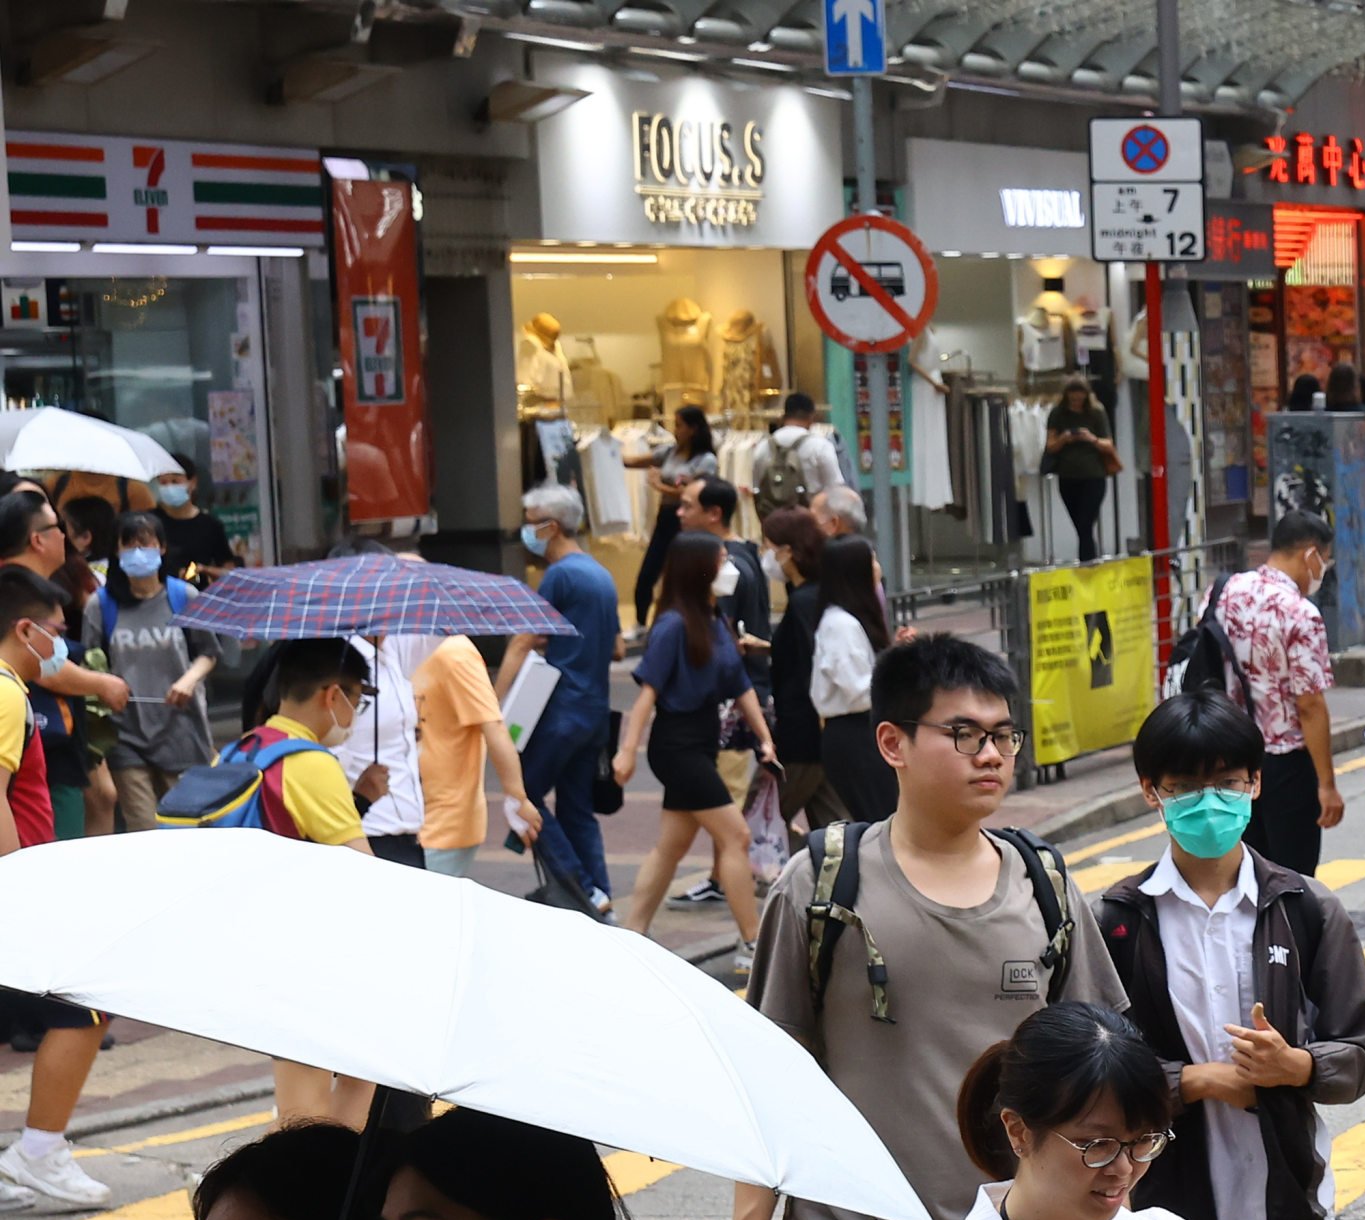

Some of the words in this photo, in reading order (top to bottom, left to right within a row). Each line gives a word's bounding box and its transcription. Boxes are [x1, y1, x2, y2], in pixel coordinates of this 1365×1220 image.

[132, 146, 166, 235] 7
[1117, 187, 1137, 195] am
[1163, 188, 1179, 214] 7
[1112, 200, 1142, 214] 上午
[1101, 228, 1156, 239] midnight
[1166, 232, 1197, 256] 12
[363, 316, 390, 397] 7
